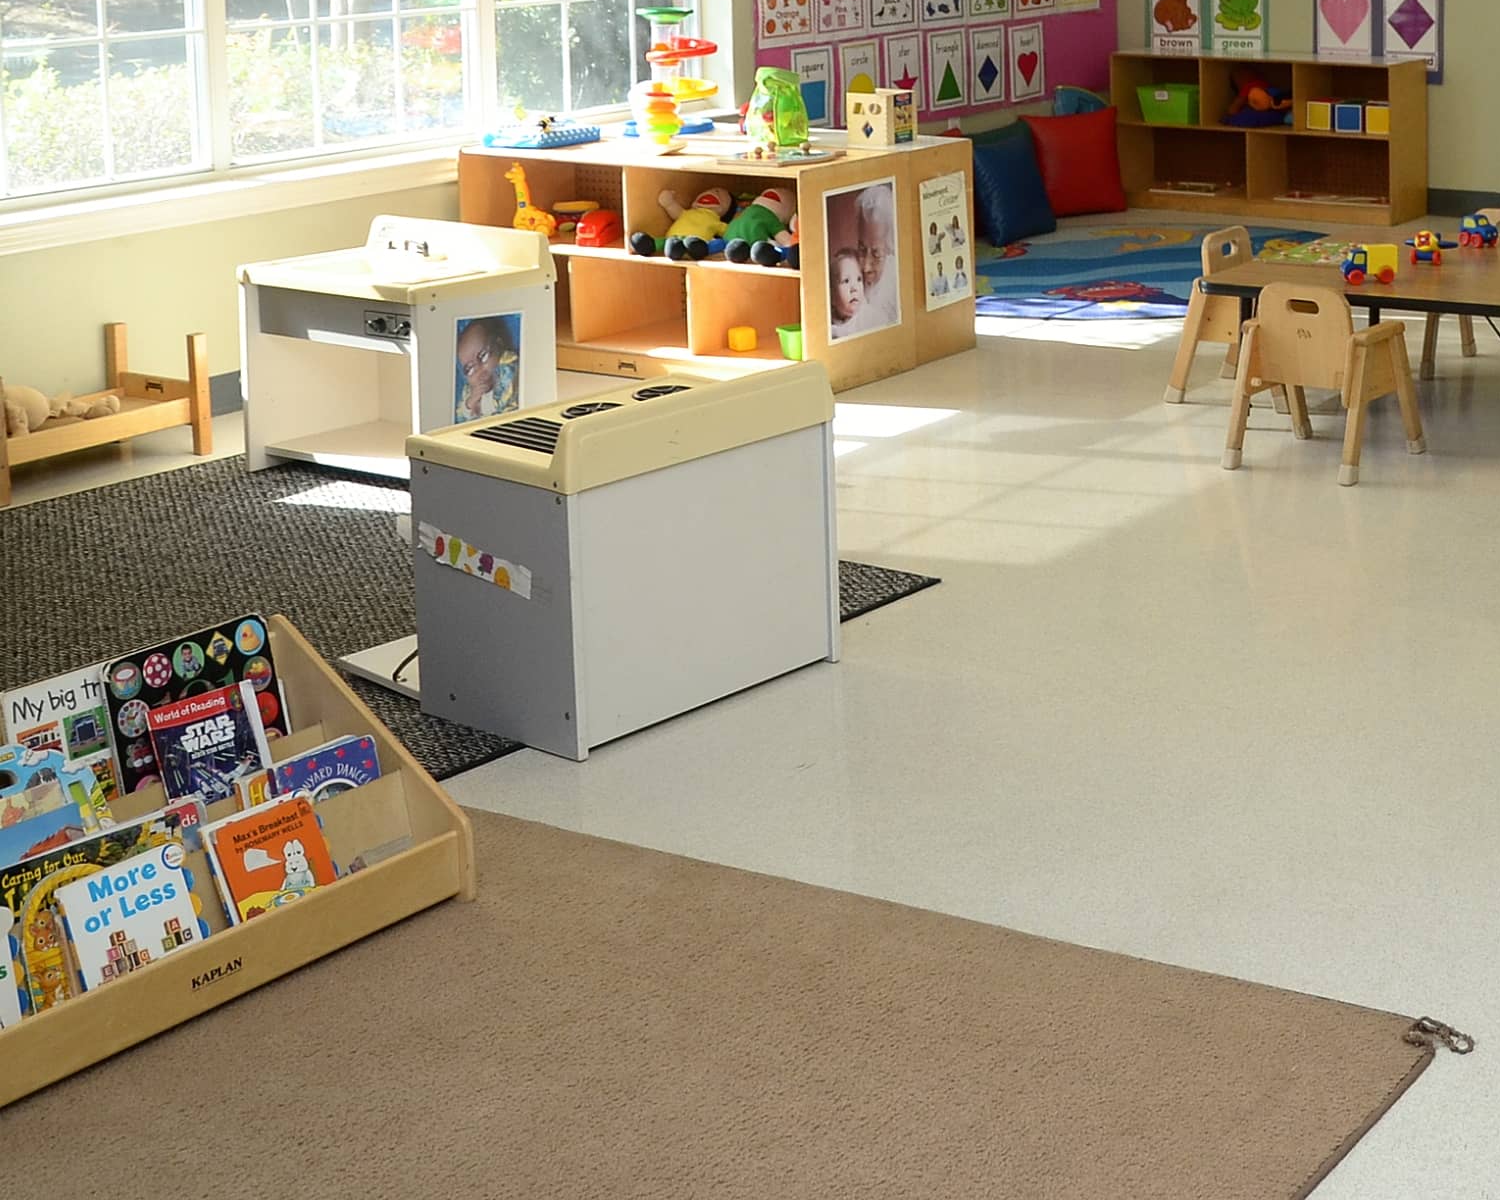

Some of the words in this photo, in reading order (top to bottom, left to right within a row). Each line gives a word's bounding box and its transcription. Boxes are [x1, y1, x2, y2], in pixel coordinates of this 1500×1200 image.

[1160, 38, 1193, 47] brown
[1222, 39, 1254, 49] green
[802, 63, 824, 79] square
[12, 696, 44, 724] My
[47, 689, 77, 711] big
[153, 709, 180, 724] World
[180, 706, 191, 717] of
[190, 696, 226, 713] Reading
[180, 714, 236, 740] STAR
[181, 726, 236, 753] WARS
[232, 829, 258, 844] Max's
[258, 811, 299, 834] Breakfast
[244, 831, 281, 849] ROSEMARY
[281, 820, 304, 834] WELLS
[1, 867, 42, 889] Caring
[43, 859, 61, 877] for
[86, 862, 158, 903] More
[84, 906, 112, 933] or
[118, 882, 177, 920] Less
[191, 957, 243, 989] KAPLAN
